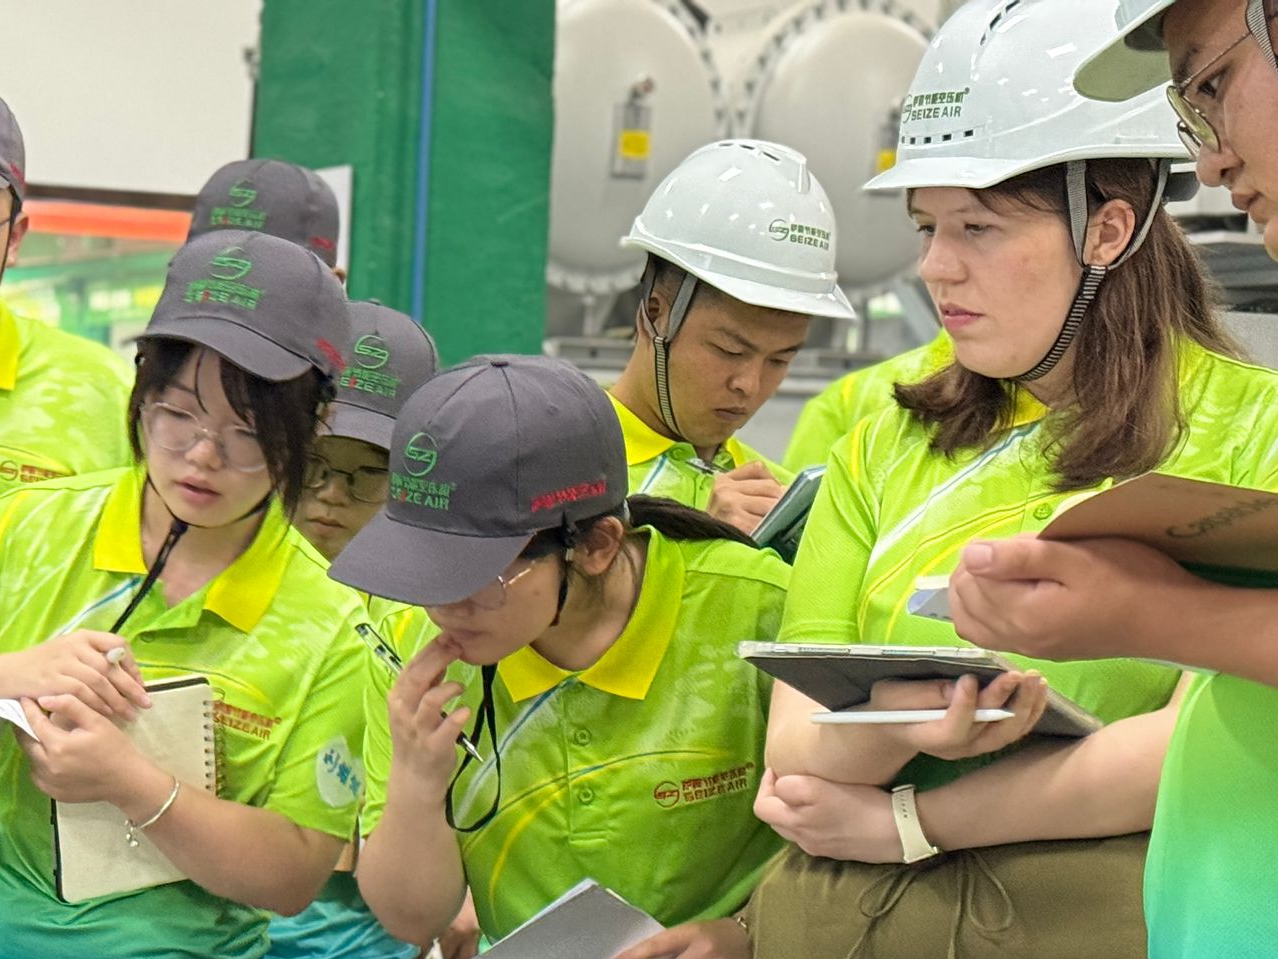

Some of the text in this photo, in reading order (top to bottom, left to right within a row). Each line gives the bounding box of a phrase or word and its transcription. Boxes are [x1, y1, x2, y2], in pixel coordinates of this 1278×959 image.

[911, 105, 962, 121] SEIZE AIR
[424, 495, 450, 511] AIR
[252, 727, 272, 741] AIR
